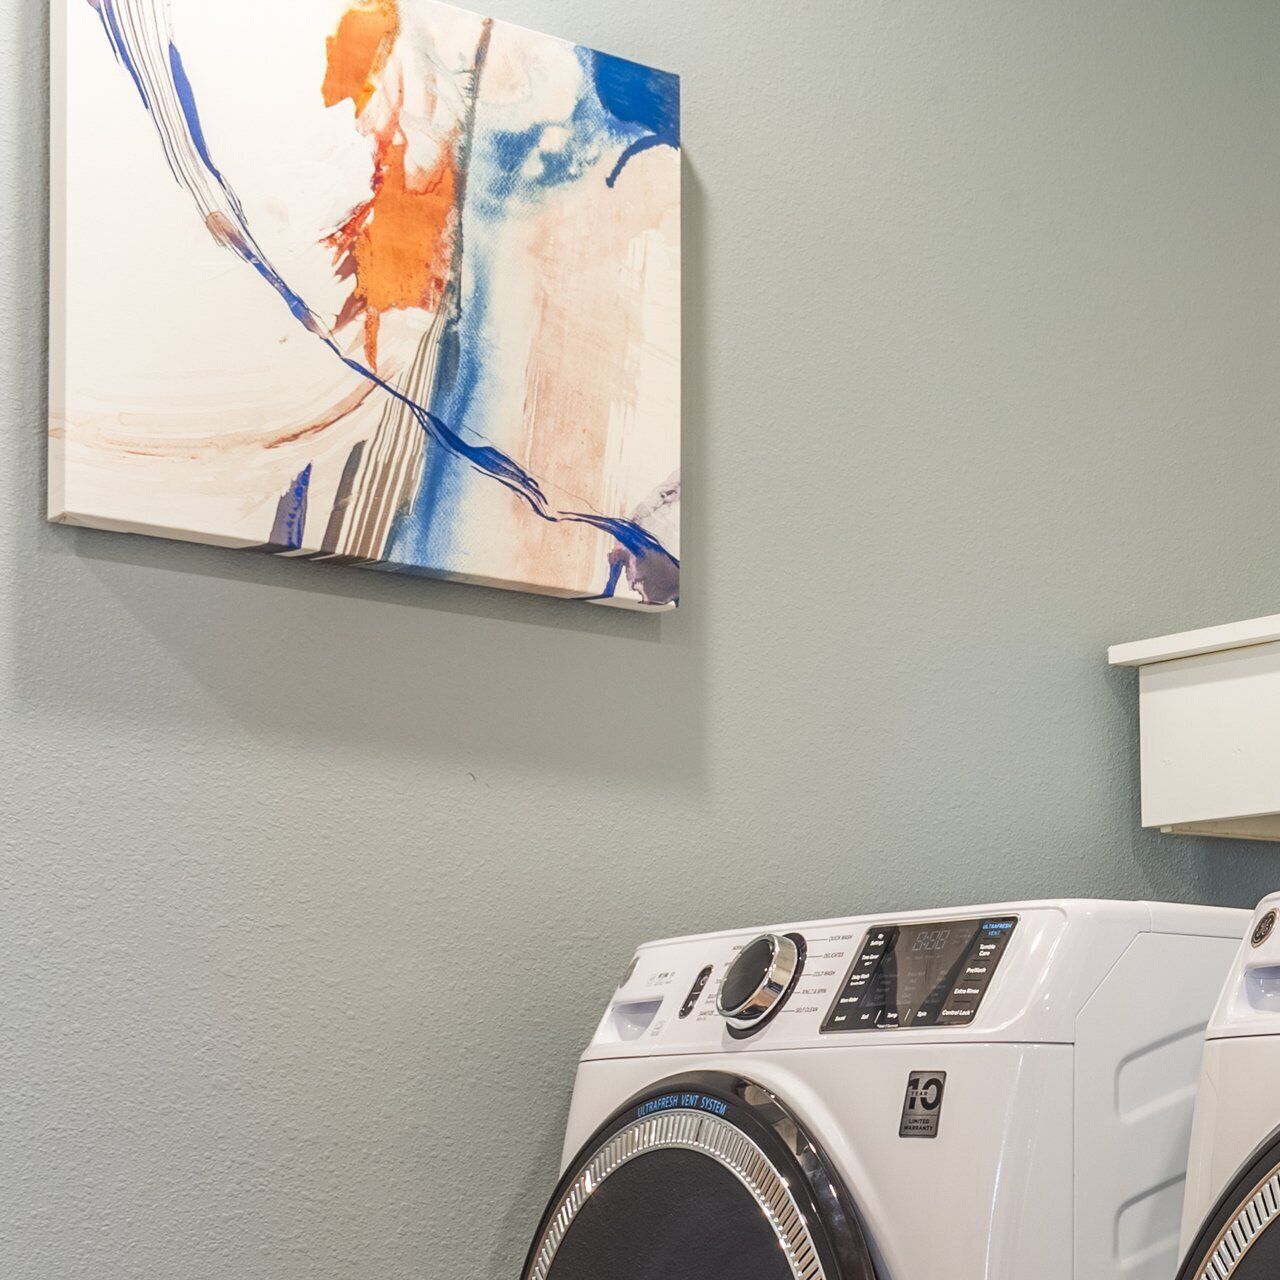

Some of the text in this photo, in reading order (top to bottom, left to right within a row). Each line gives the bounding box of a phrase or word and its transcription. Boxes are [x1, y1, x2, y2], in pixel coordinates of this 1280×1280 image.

[637, 1094, 727, 1117] ULTRAFRESH VENT SYSTEM
[908, 1077, 944, 1111] 10
